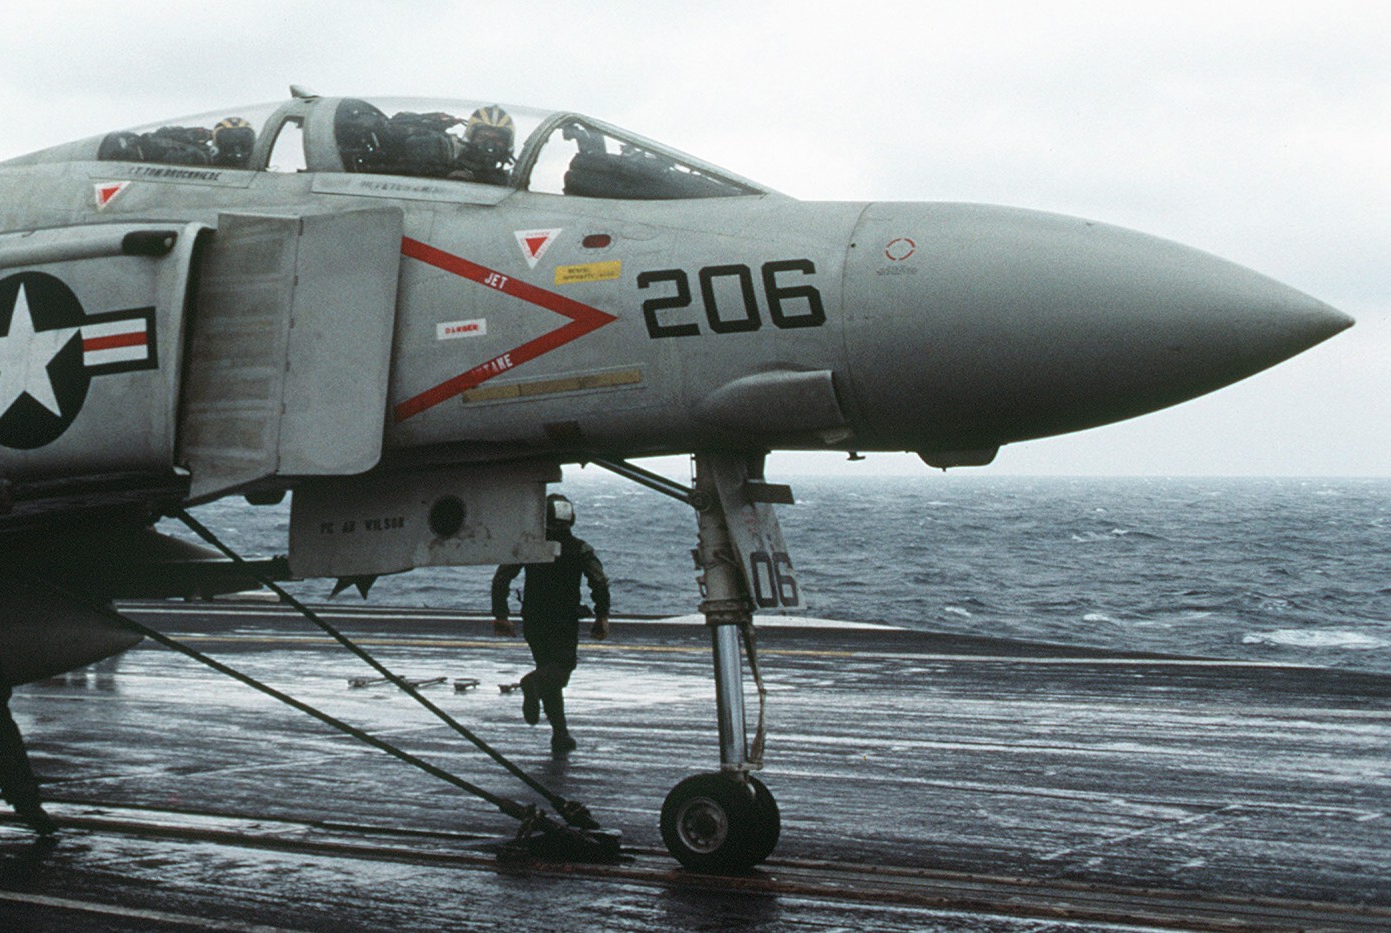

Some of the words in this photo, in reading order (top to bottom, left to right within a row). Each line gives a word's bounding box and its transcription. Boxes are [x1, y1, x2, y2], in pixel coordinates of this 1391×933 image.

[483, 272, 508, 290] JET
[637, 258, 827, 339] 206
[750, 551, 800, 608] 06
